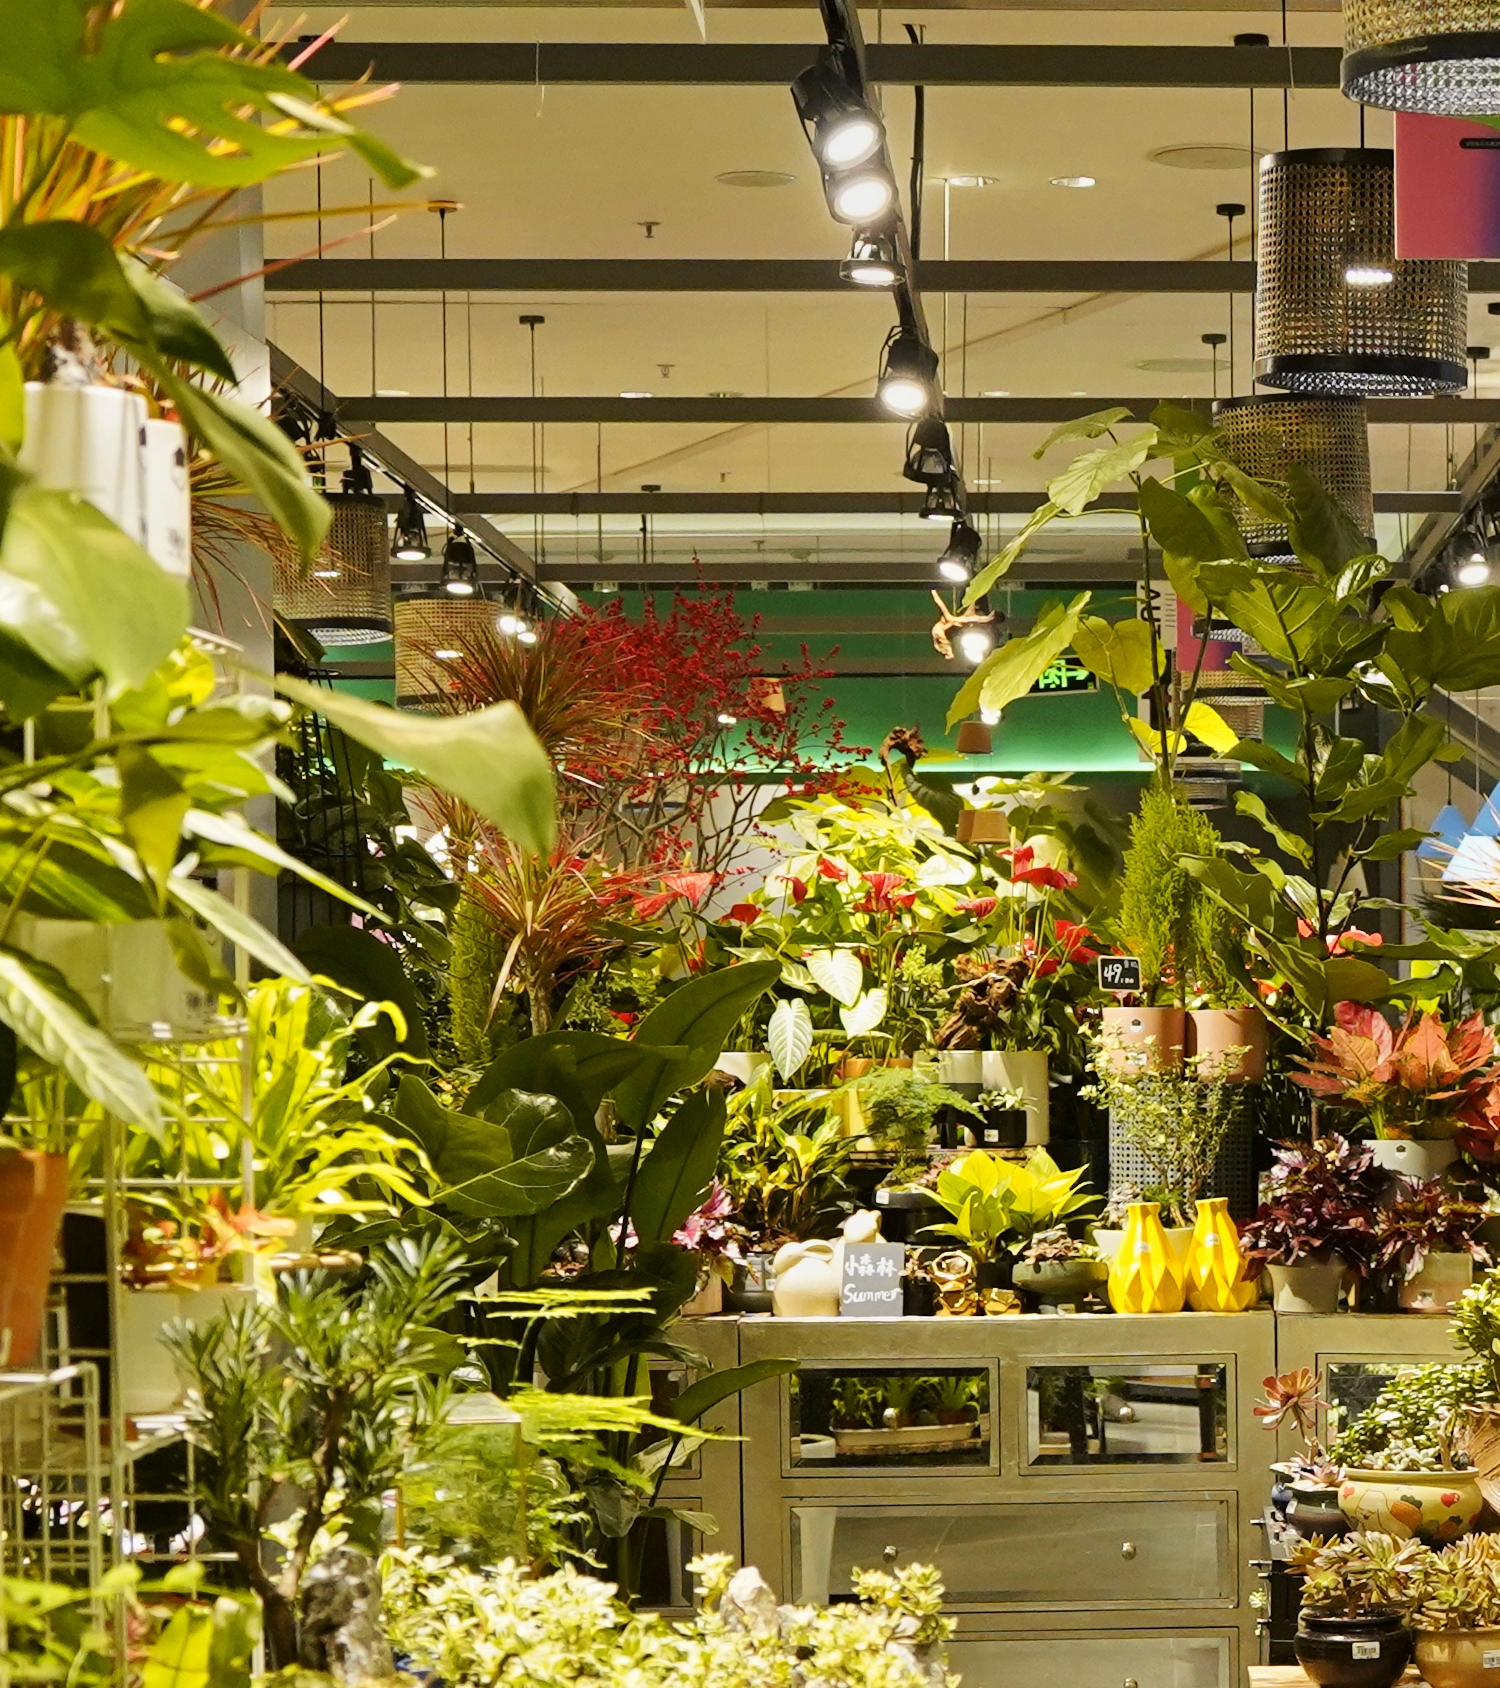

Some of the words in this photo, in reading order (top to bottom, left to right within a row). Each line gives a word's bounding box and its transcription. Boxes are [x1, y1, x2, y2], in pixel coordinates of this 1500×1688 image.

[844, 1253, 898, 1278] 小森林
[843, 1283, 904, 1304] Summer
